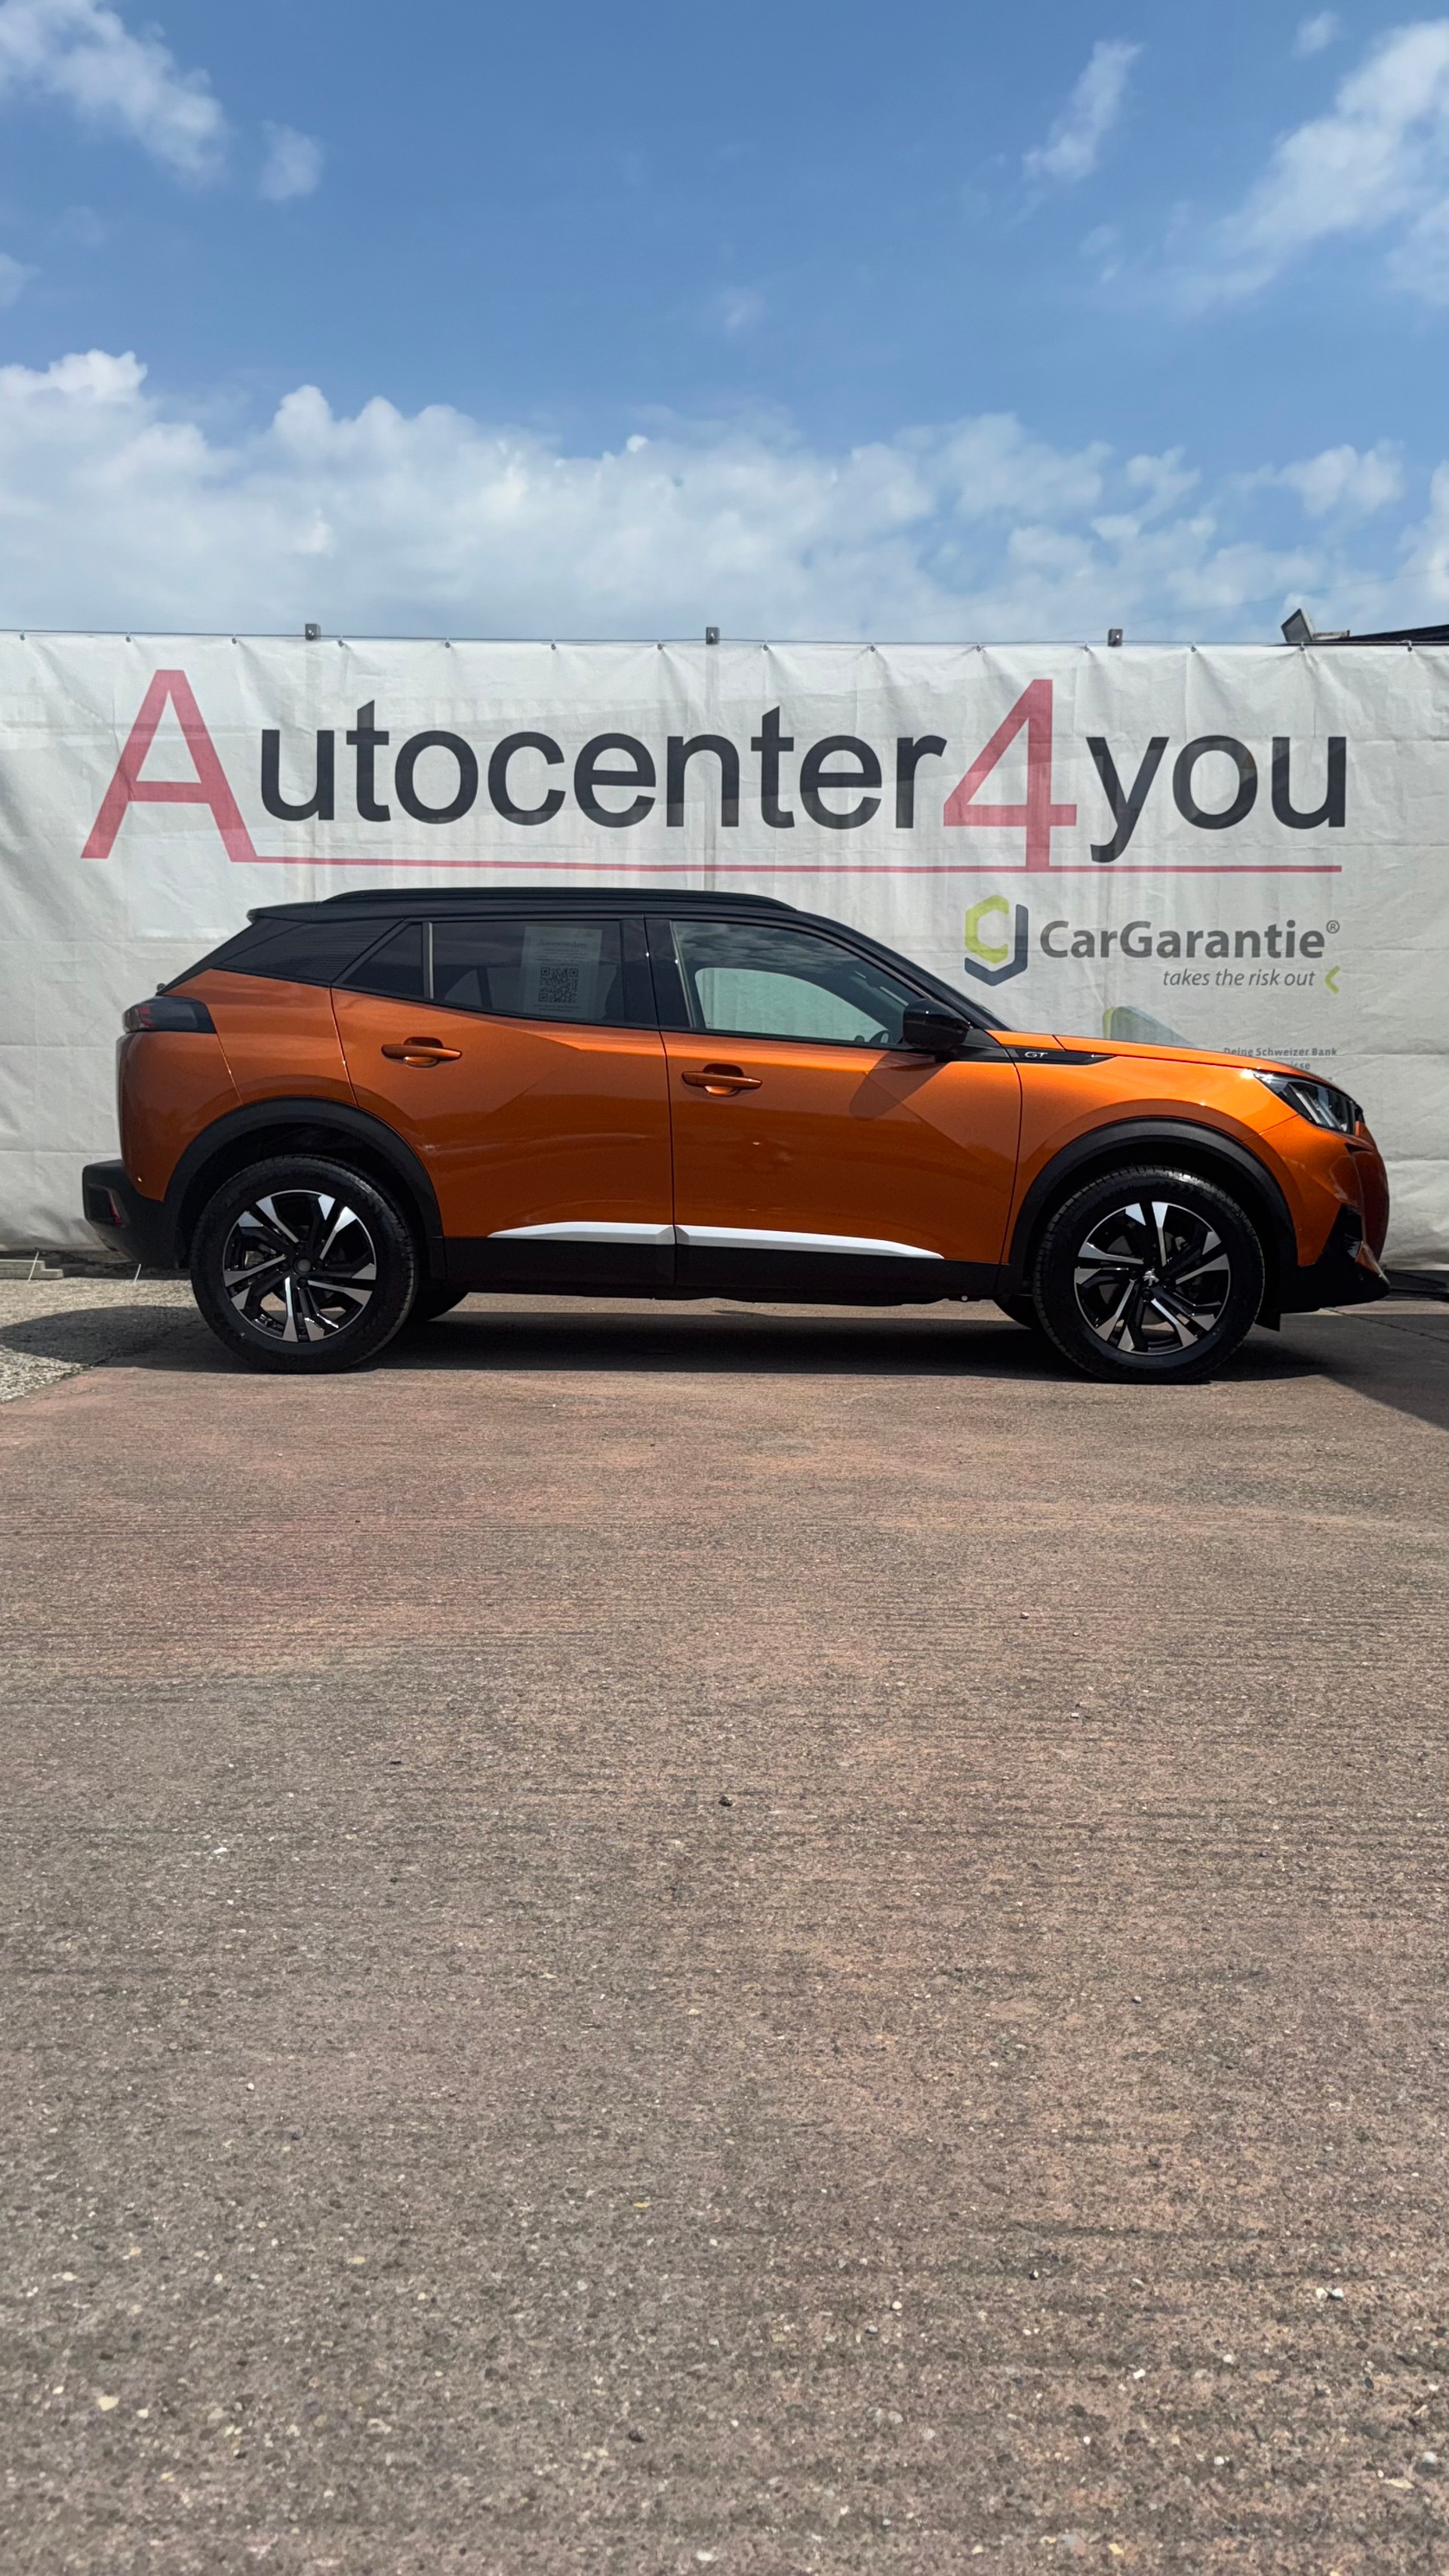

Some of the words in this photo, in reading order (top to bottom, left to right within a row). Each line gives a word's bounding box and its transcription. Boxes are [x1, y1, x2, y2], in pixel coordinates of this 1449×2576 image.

[81, 669, 1347, 872] Autocenter4you
[1163, 968, 1210, 986] takes
[1215, 968, 1244, 986] the
[1248, 968, 1280, 986] risk
[1284, 971, 1315, 986] out
[1256, 1047, 1309, 1057] Schweizer
[1312, 1047, 1338, 1057] Bank
